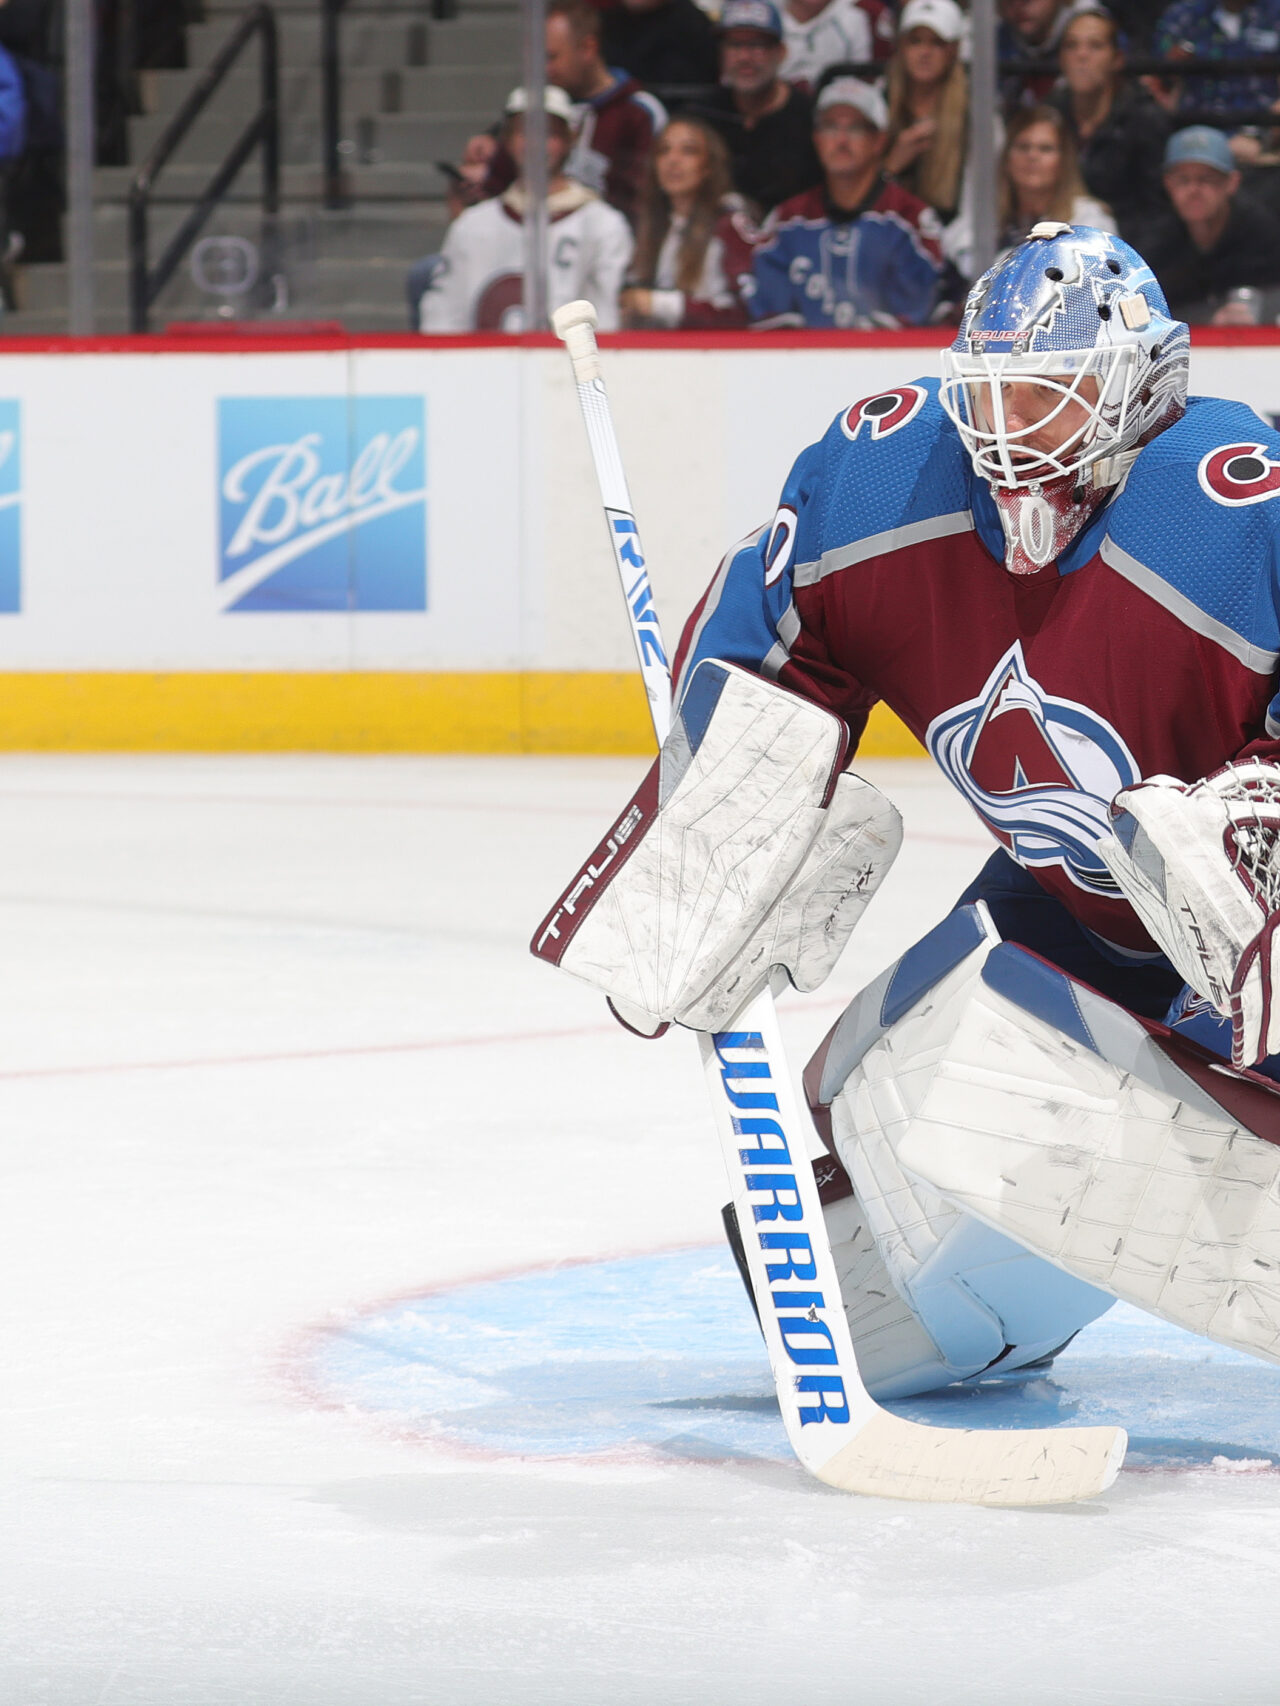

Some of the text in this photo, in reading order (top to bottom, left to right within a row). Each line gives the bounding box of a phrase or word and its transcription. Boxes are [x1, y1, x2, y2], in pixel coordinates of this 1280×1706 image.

[223, 426, 420, 558] Ball
[537, 804, 644, 952] TRUE
[712, 1031, 851, 1428] WARRIOR
